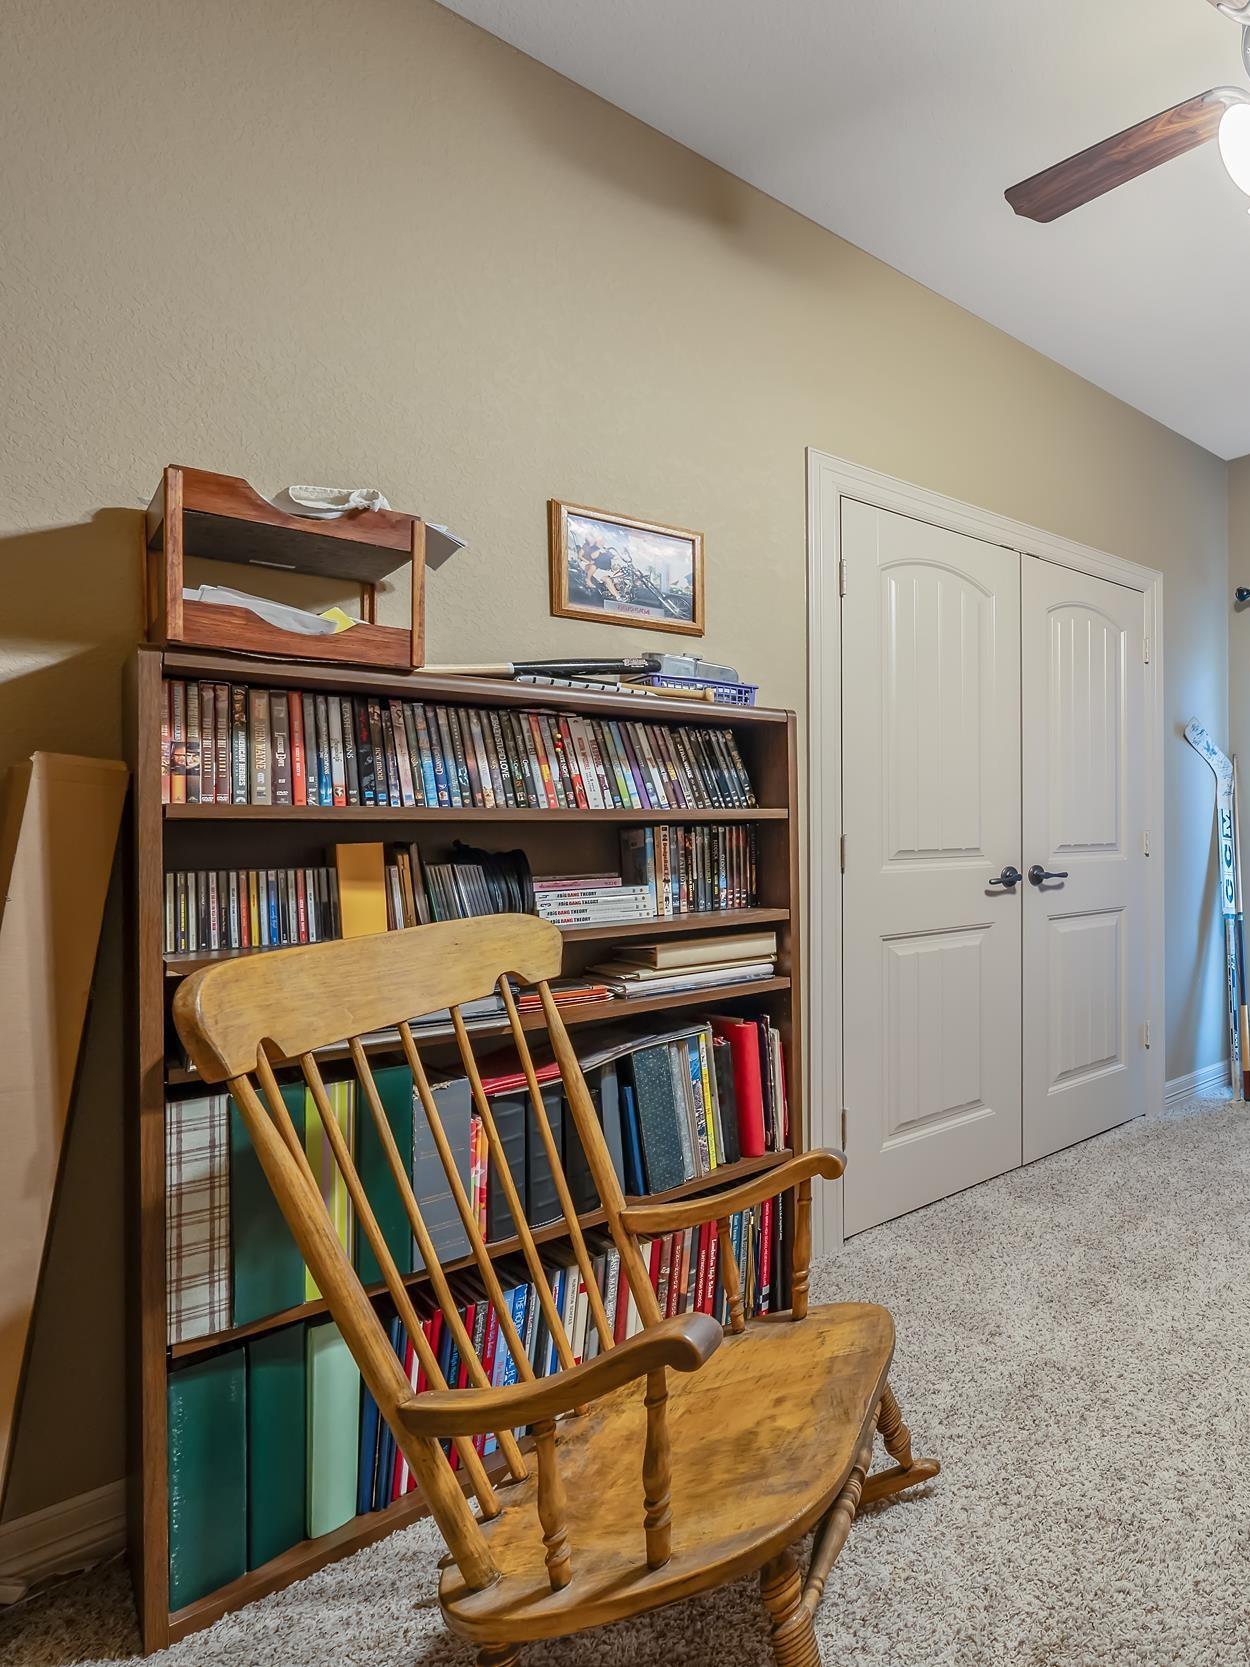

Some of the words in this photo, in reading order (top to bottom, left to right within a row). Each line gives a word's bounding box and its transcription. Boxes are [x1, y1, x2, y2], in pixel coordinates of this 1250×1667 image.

[254, 722, 265, 742] JOHN
[238, 731, 246, 762] AMERICAN
[255, 744, 266, 770] WAYNE
[345, 735, 354, 759] TITANS
[238, 763, 246, 786] HEROES
[1221, 808, 1234, 903] CCM
[450, 1353, 459, 1366] High
[449, 1366, 457, 1384] School
